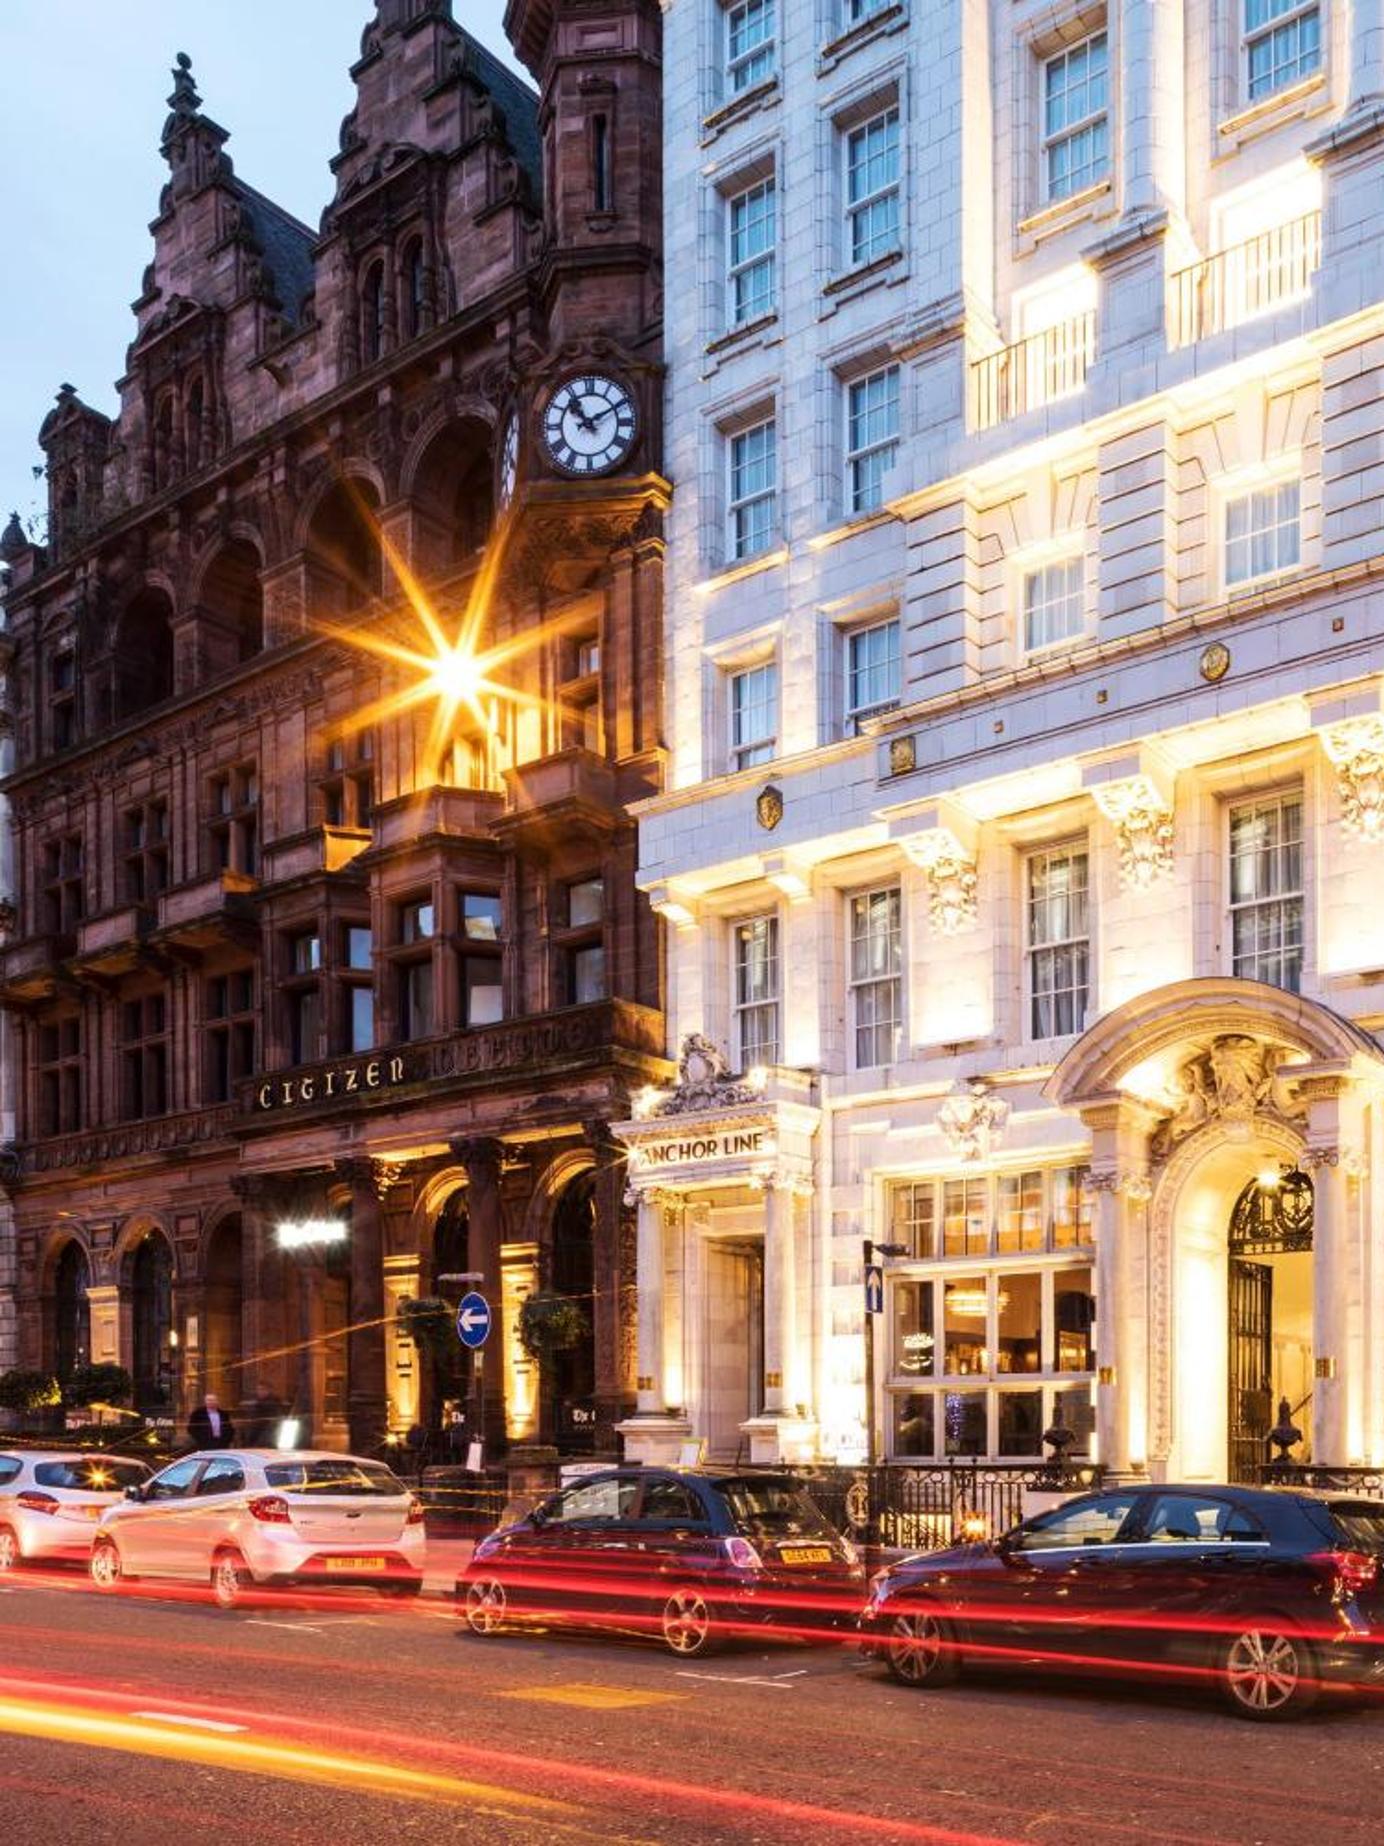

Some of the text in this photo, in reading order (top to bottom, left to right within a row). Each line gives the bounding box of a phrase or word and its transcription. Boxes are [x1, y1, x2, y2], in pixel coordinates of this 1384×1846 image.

[260, 1057, 404, 1108] CITIZEN
[641, 1133, 763, 1165] ANCHOR LINE
